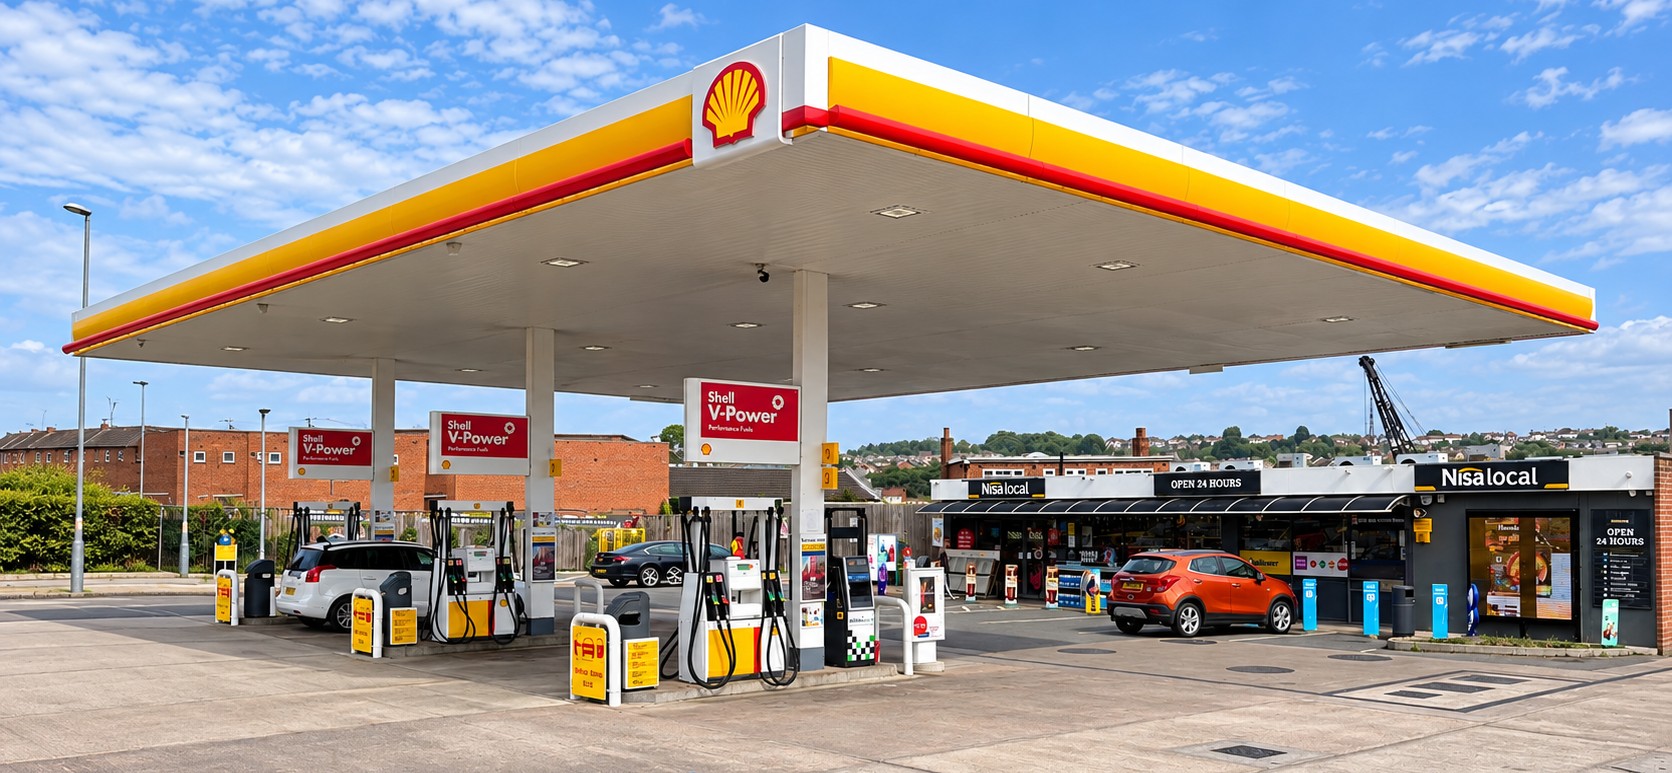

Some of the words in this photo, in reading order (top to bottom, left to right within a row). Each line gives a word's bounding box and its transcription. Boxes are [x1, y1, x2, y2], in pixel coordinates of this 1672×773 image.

[708, 391, 735, 404] Shell
[708, 404, 778, 424] V-Power
[447, 420, 471, 431] Shell
[447, 430, 509, 445] V-Power
[303, 443, 356, 455] V-Power
[1171, 480, 1195, 489] OPEN
[1197, 479, 1207, 488] 24
[1209, 478, 1242, 488] HOURS
[1606, 528, 1635, 537] OPEN
[1596, 537, 1607, 546] 24
[1609, 537, 1645, 546] HOURS
